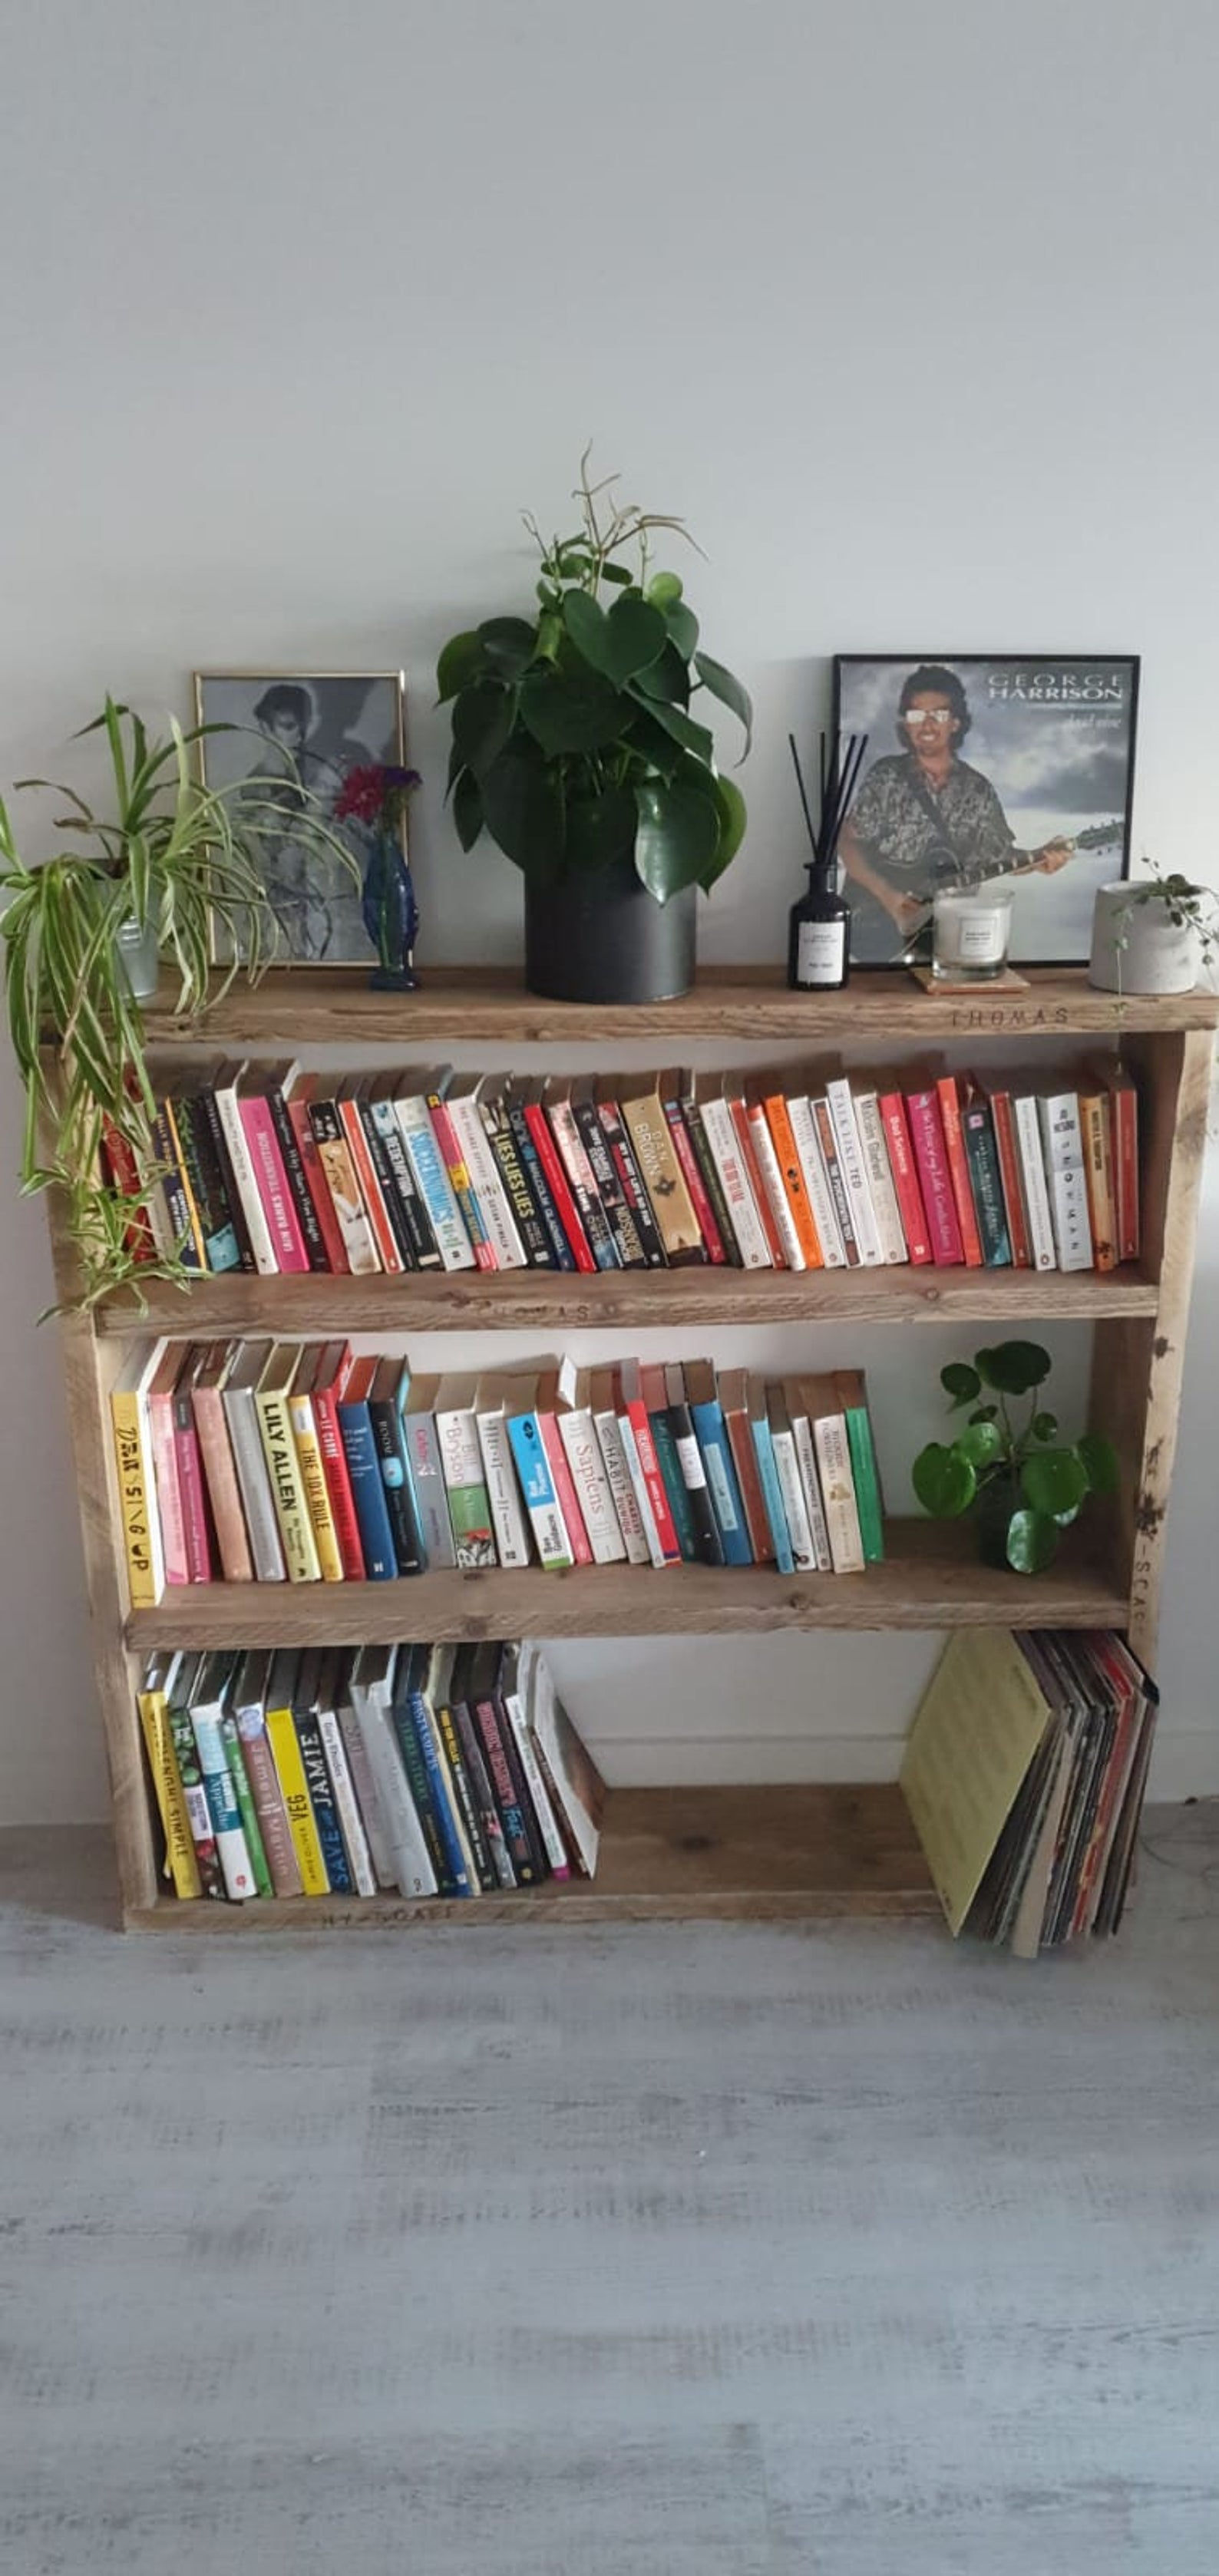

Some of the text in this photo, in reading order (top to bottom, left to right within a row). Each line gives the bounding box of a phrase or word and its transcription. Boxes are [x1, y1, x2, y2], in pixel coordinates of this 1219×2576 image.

[989, 674, 1122, 687] GEORGE
[989, 688, 1122, 699] HARRISON
[952, 1007, 1068, 1028] THOMAS
[510, 1111, 531, 1145] blink
[634, 1122, 664, 1177] BROWN
[652, 1131, 669, 1163] DAN
[833, 1093, 863, 1189] TALK LIKE TED
[861, 1100, 886, 1181] Malcolm Gladwell
[890, 1116, 909, 1174] Bad Science
[256, 1132, 294, 1253] IAIN BANKS TRANSITION
[385, 1136, 415, 1197] REDEMPTION
[408, 1131, 455, 1224] SOCCERNOMICS
[494, 1132, 535, 1219] LIES LIES LIES
[930, 1171, 944, 1193] Life
[286, 1149, 322, 1243] Why Marx Was Right
[528, 1161, 566, 1253] MALCOLM GLADWELL
[1062, 1141, 1079, 1250] SNOWMAN
[615, 1206, 646, 1260] BRANSON
[263, 1403, 298, 1512] LILY ALLEN
[378, 1421, 394, 1453] ROOM
[445, 1428, 465, 1483] Bryson
[462, 1444, 477, 1465] Bill
[302, 1448, 331, 1531] THE 10X RULE
[576, 1444, 607, 1514] Sapiens
[605, 1445, 627, 1491] HABIT
[625, 1493, 642, 1534] CHARLES
[412, 1699, 427, 1730] PASTA
[300, 1734, 333, 1808] JAMIE
[325, 1722, 342, 1778] Gary Rhodes
[170, 1811, 189, 1857] SIMPLE
[251, 1744, 291, 1877] James Martin
[286, 1794, 308, 1822] VEG
[502, 1808, 524, 1839] Fast
[325, 1830, 349, 1886] SAVE
